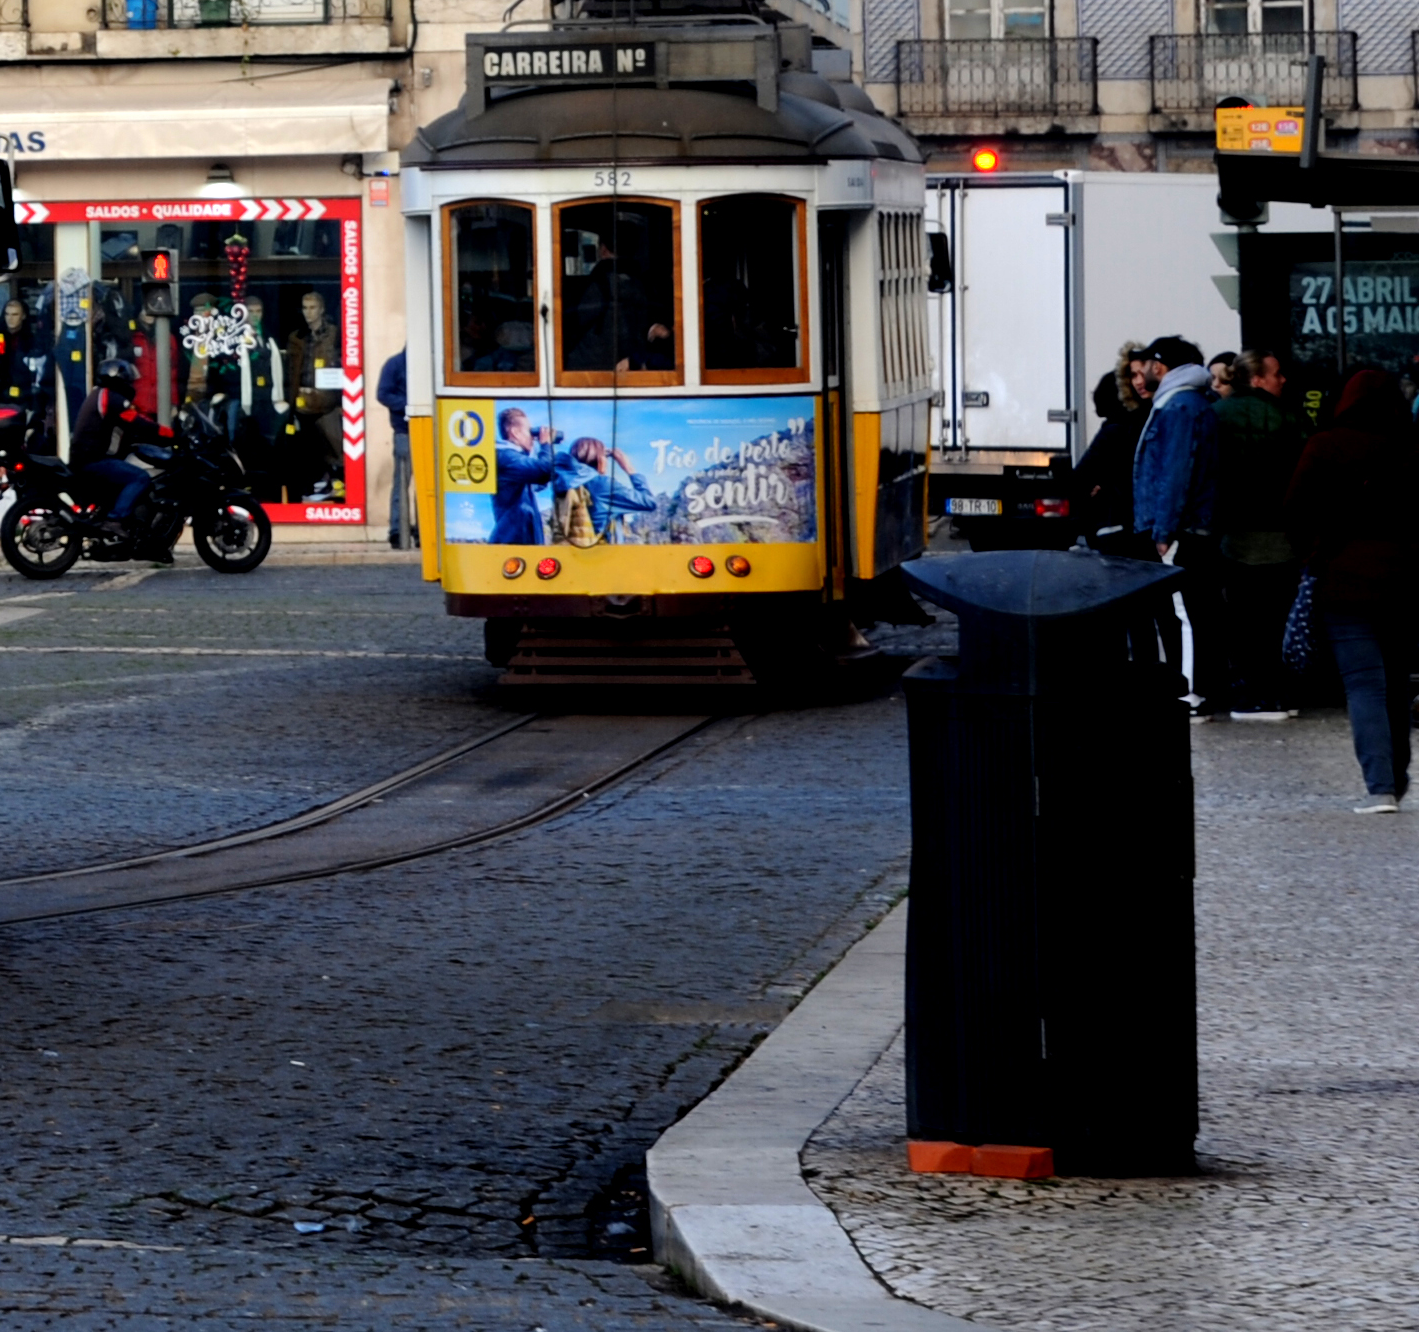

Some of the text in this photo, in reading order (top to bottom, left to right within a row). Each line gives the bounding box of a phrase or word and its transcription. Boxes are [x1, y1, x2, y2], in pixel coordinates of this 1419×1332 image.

[484, 48, 646, 77] CARREIRA Nº
[594, 171, 631, 186] 582
[86, 204, 232, 219] SALDOS QUALIDADE
[343, 220, 359, 367] SALDOS QUALIDADE
[1301, 276, 1418, 304] 27 ABRIL
[1301, 306, 1324, 334] A
[650, 439, 698, 474] Tão
[704, 436, 734, 464] de
[685, 463, 788, 514] sentir
[305, 507, 361, 520] SALDOS
